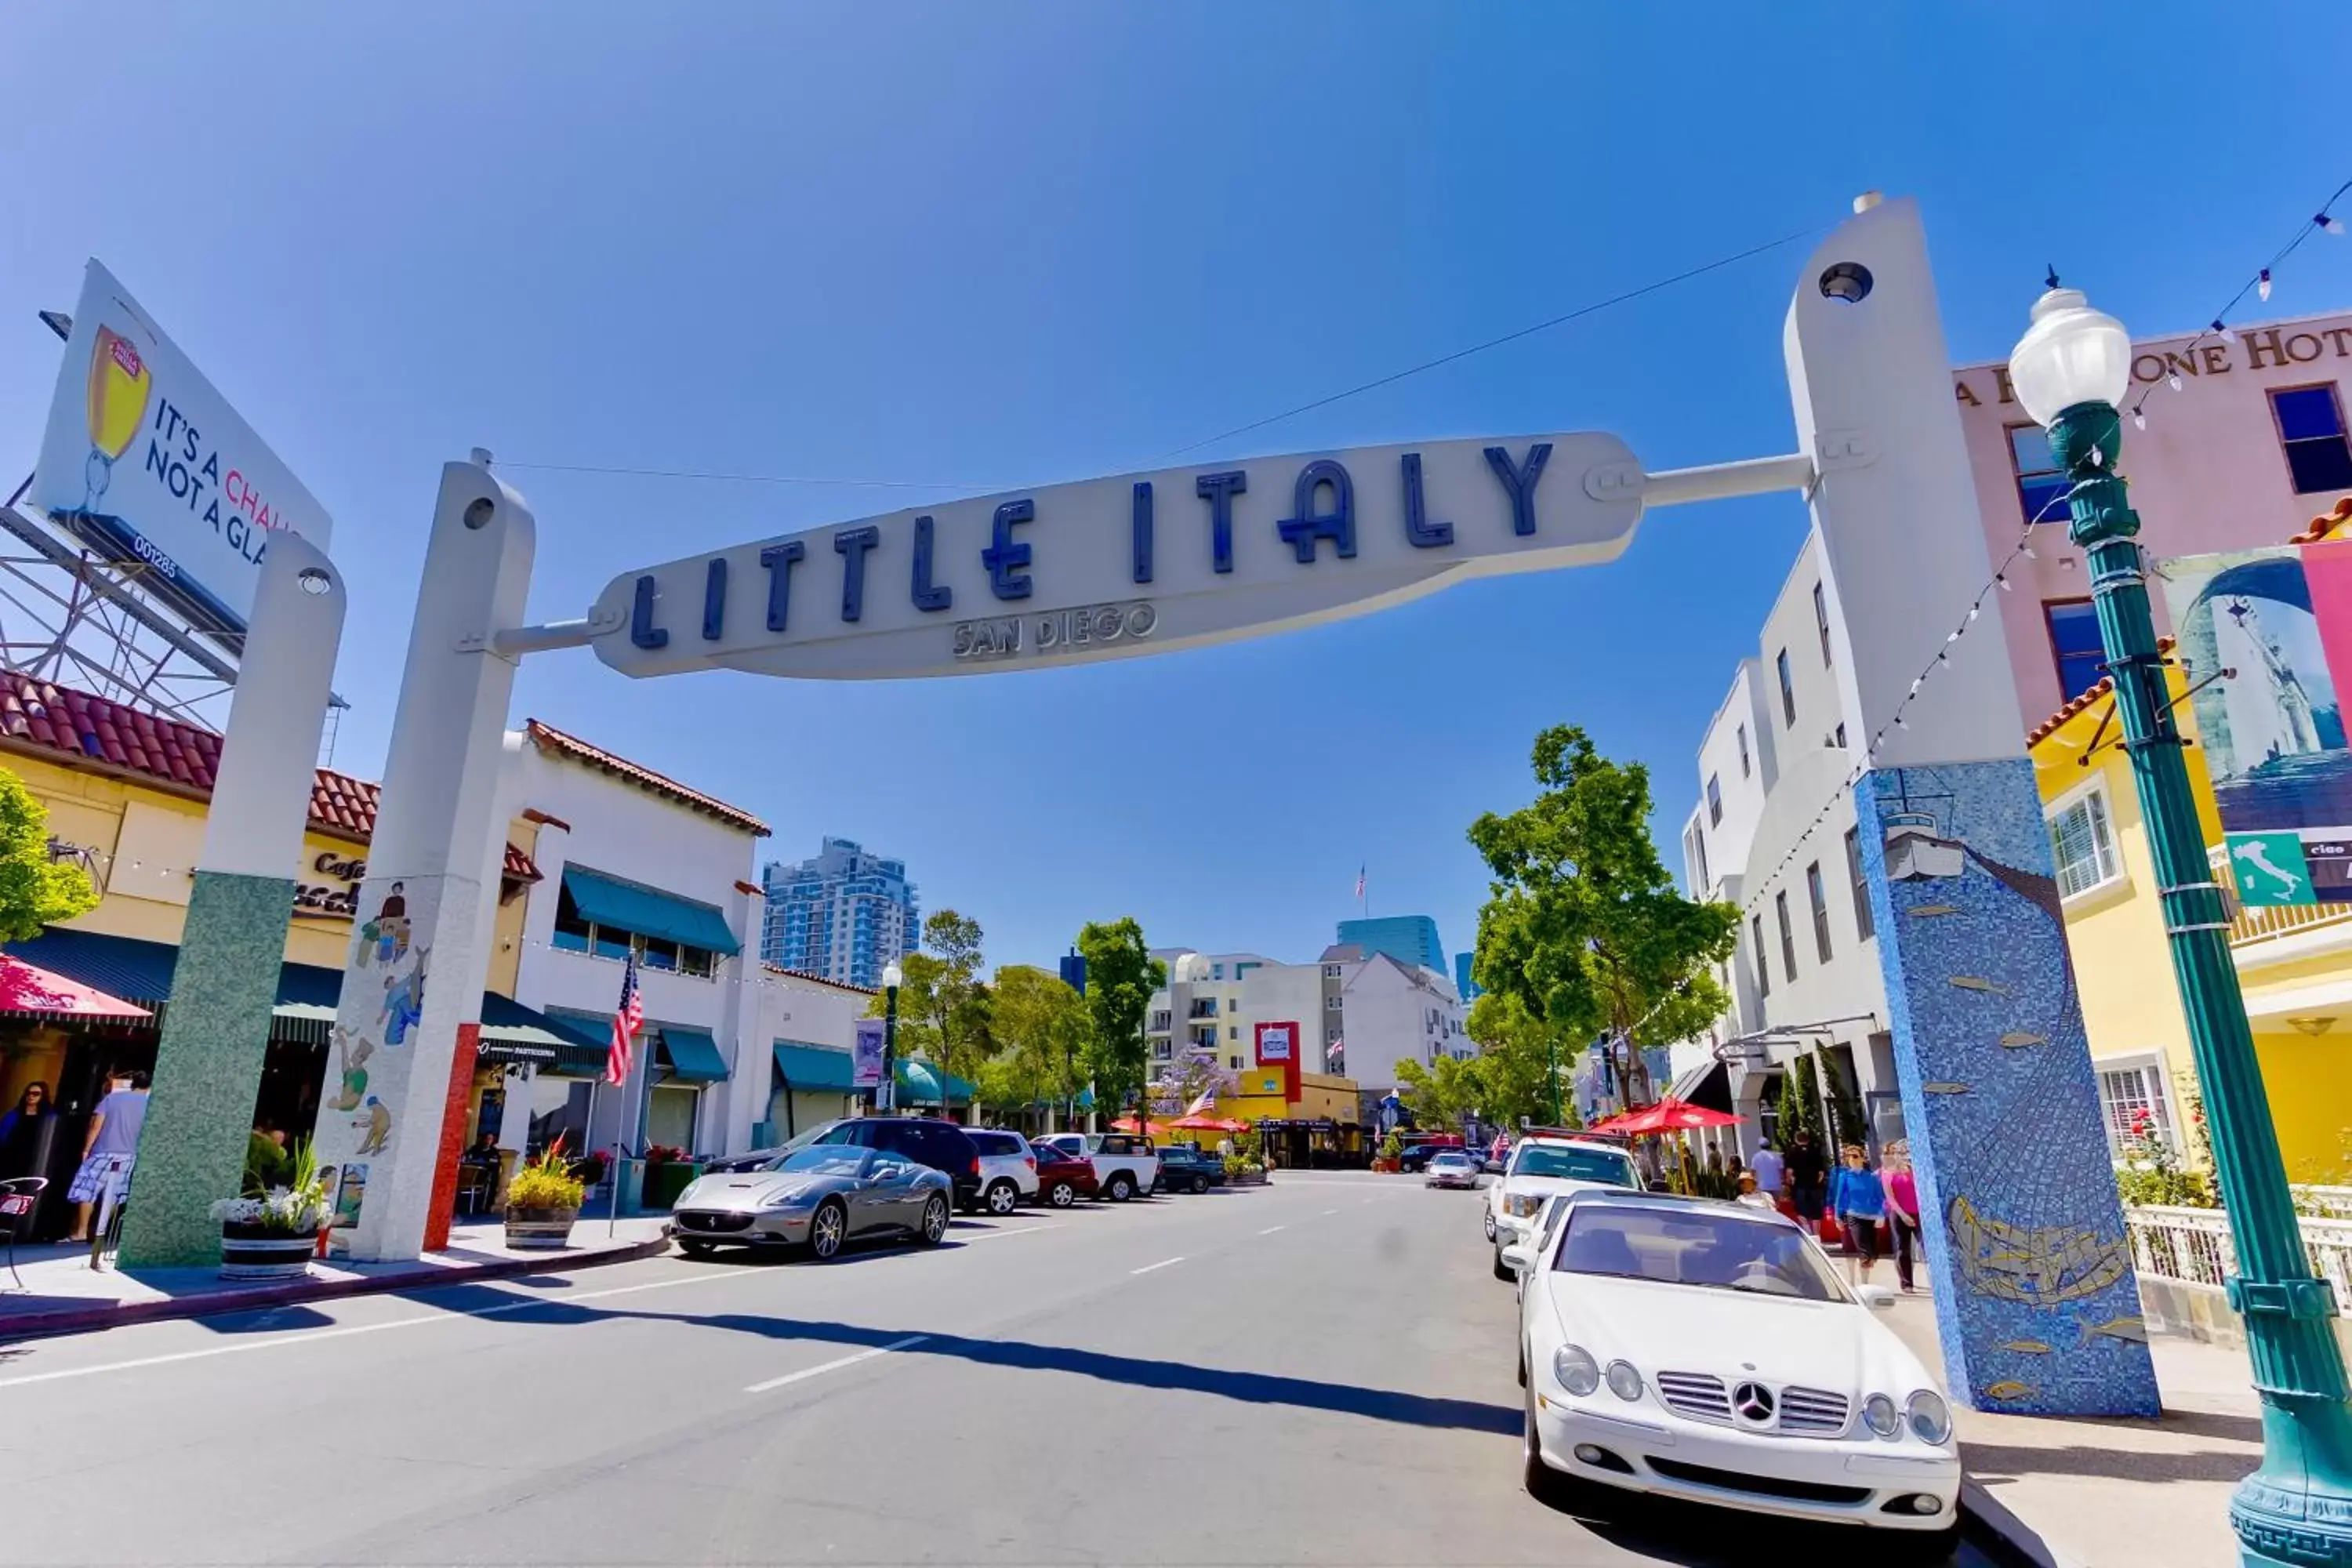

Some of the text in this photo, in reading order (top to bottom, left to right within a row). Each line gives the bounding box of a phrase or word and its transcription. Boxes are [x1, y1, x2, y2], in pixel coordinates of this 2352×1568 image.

[155, 397, 200, 462] IT'S
[201, 451, 219, 487] A
[146, 437, 205, 511] NOT
[202, 498, 220, 534] A
[134, 535, 177, 579] 001285
[631, 442, 1554, 650] LITTLE ITALY
[953, 602, 1159, 657] SAN DIEGO
[2310, 844, 2345, 855] ciao
